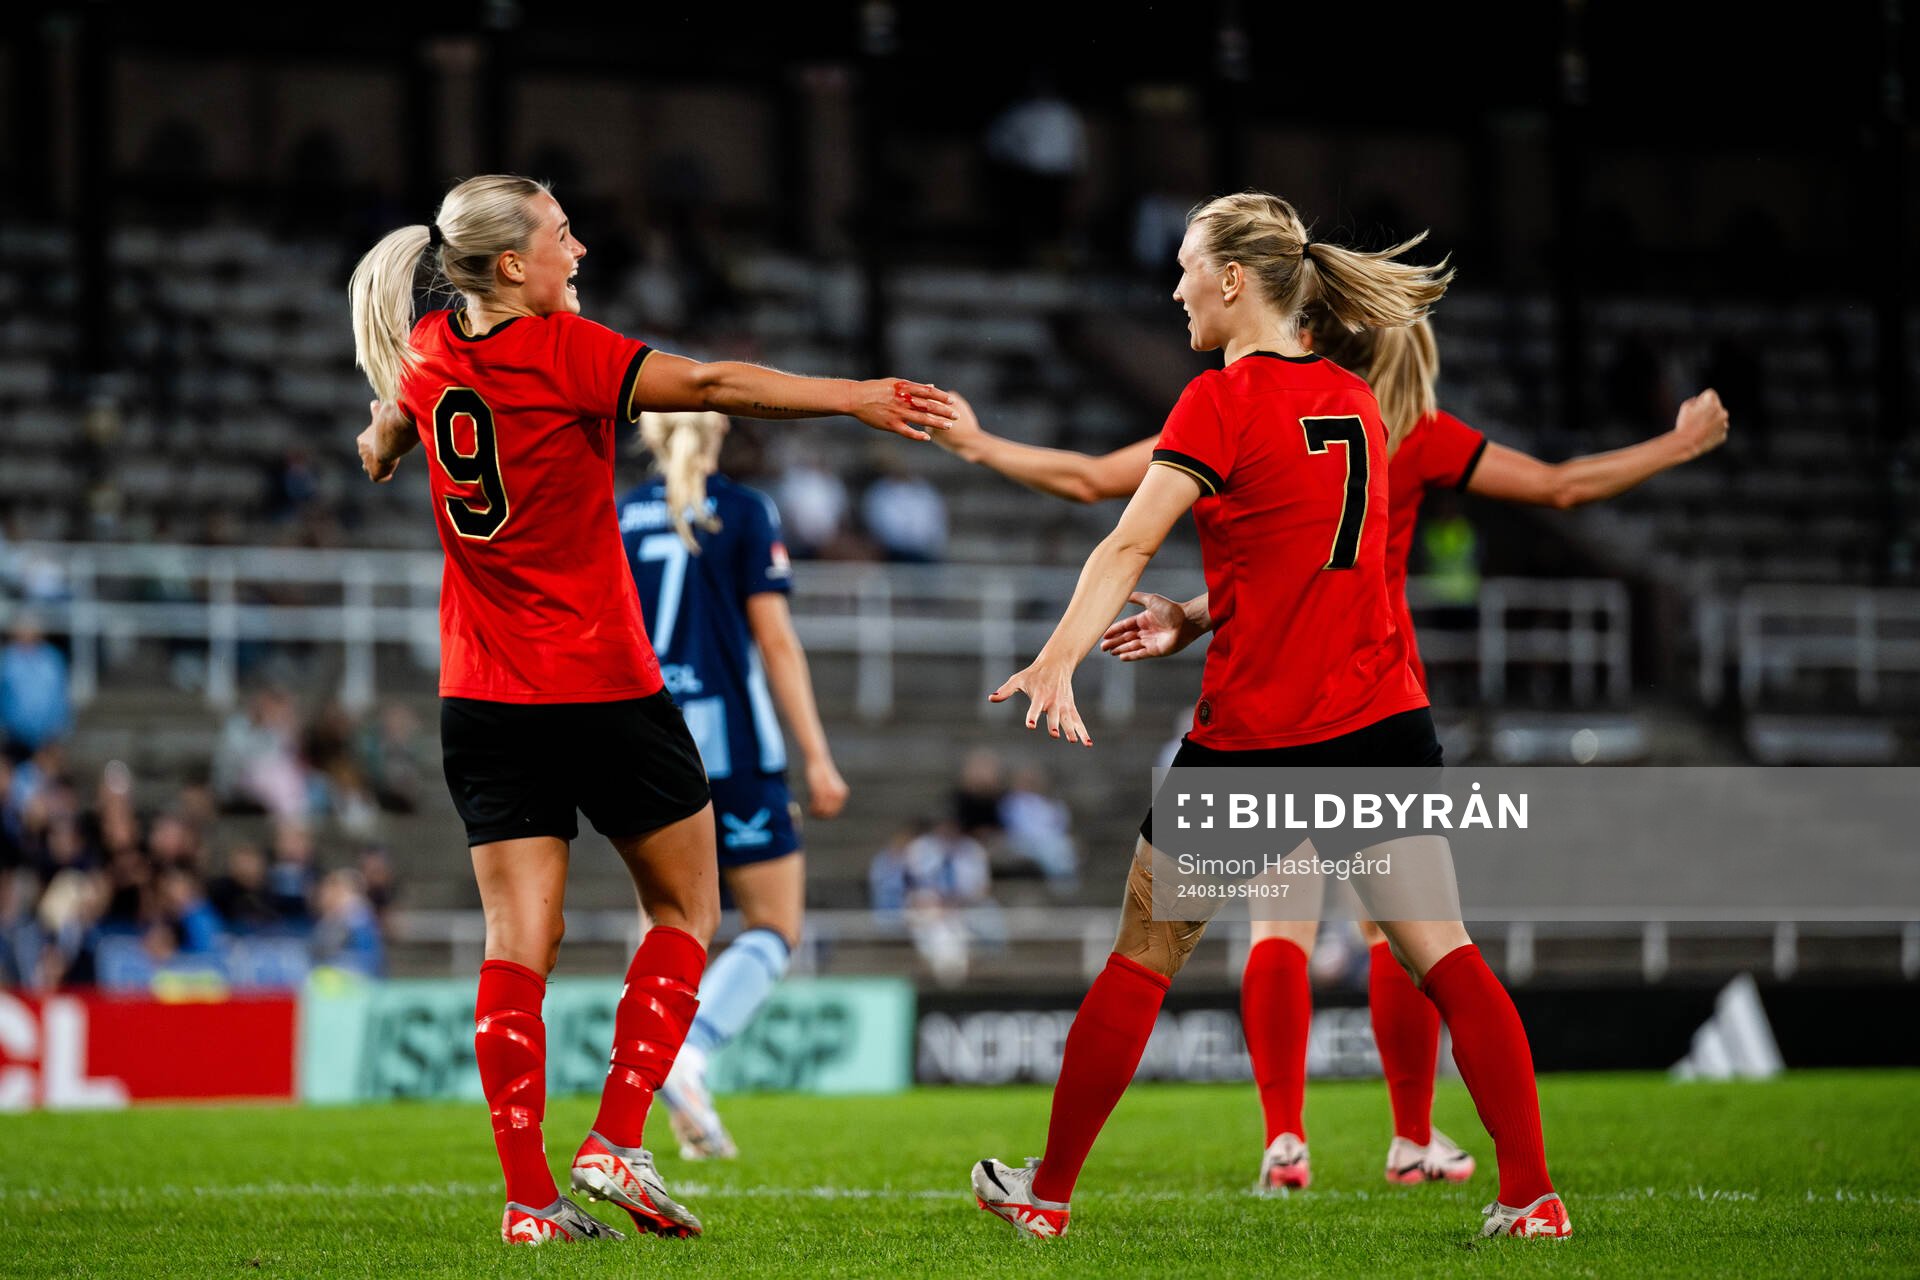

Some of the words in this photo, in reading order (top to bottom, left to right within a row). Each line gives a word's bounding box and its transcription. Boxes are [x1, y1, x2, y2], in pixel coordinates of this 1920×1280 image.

[433, 386, 509, 540] 9
[1299, 414, 1370, 570] 7
[638, 533, 688, 658] 7
